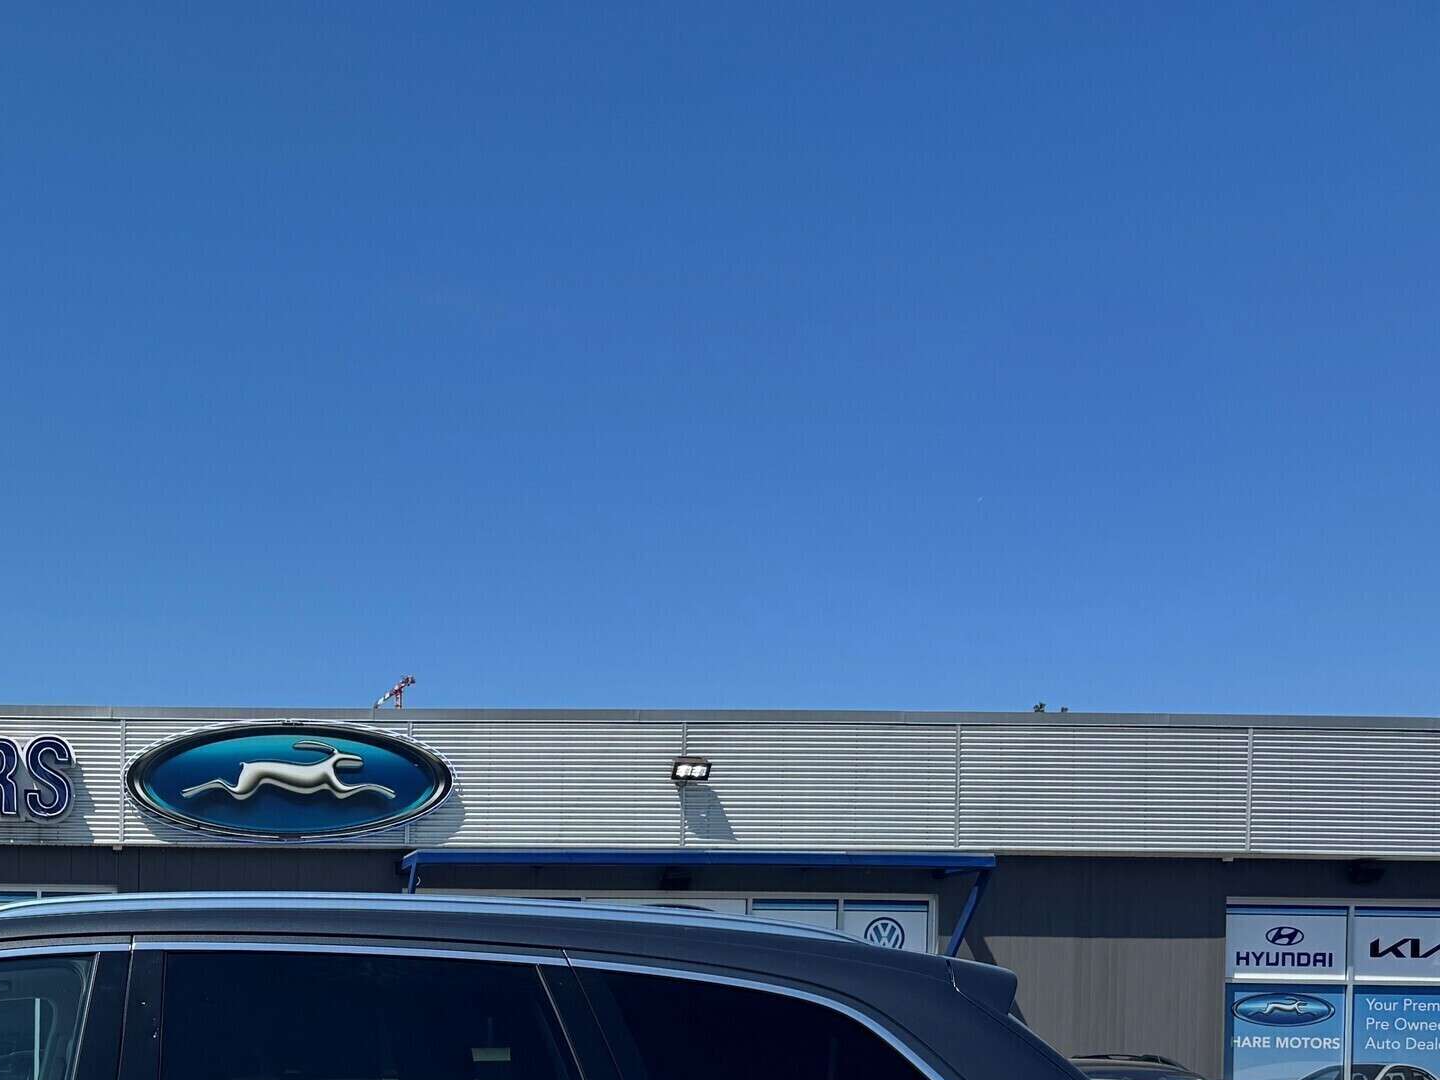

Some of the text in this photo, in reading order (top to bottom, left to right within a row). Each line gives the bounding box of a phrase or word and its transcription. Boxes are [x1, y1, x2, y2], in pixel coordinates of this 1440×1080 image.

[1235, 951, 1333, 968] HYUNDAI
[1365, 997, 1399, 1012] Your
[1366, 1017, 1440, 1031] Pre Owne
[1232, 1036, 1341, 1050] HARE MOTORS
[1365, 1036, 1440, 1050] Auto Deal
